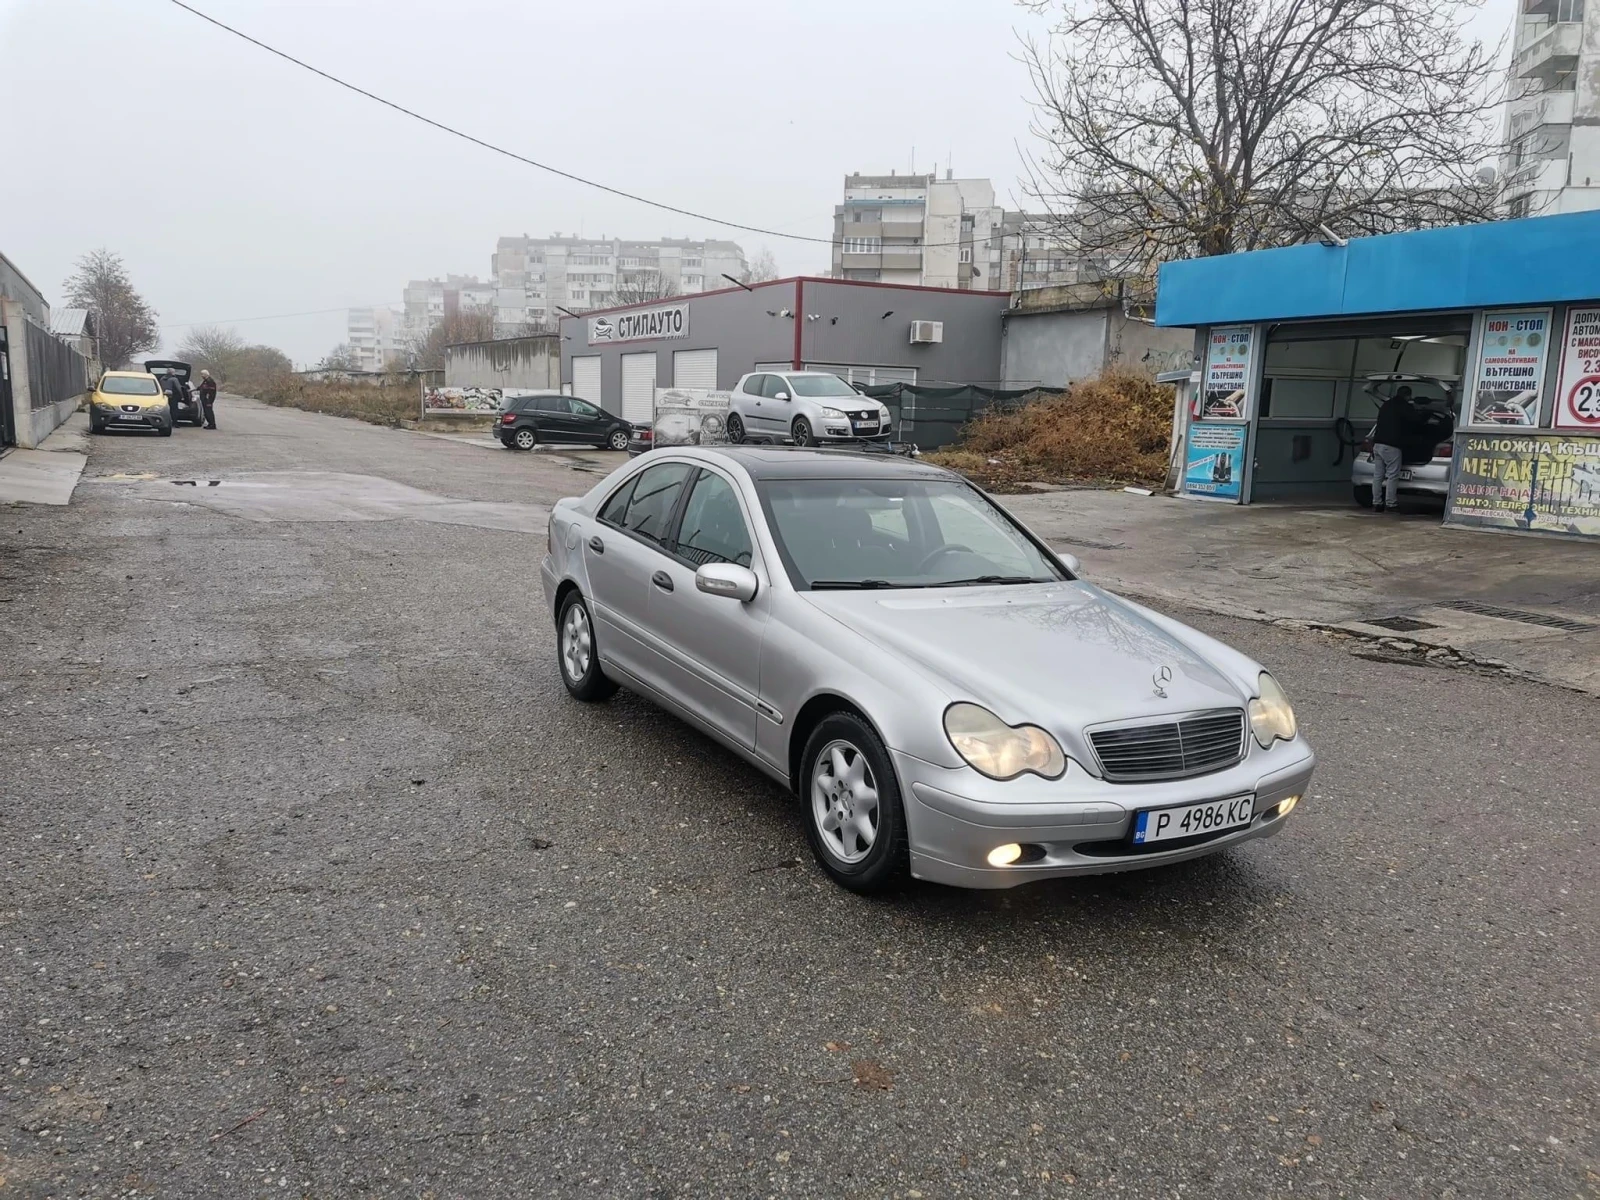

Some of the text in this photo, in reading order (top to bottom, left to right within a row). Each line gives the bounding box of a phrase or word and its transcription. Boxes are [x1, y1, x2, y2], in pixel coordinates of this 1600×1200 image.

[618, 309, 682, 338] СТИЛАУТО
[1574, 312, 1600, 324] ДОПУ
[1488, 321, 1508, 331] НОН
[1516, 319, 1543, 330] СТОП
[1213, 335, 1226, 343] НОН
[1231, 334, 1249, 343] СТОП
[1571, 337, 1600, 347] С МАКС
[1211, 371, 1243, 379] ВЪТРЕШНО
[1485, 367, 1534, 377] ВЪТРЕШНО
[1208, 382, 1244, 390] ПОЧИСТВАНЕ
[1480, 380, 1537, 390] ПОЧИСТВАНЕ
[1467, 438, 1552, 454] ЗАЛОЖНА
[1462, 457, 1573, 481] МЕГАКЕШ
[1457, 483, 1498, 496] ЗАЛОГ
[1500, 488, 1517, 498] НА
[1456, 497, 1492, 508] ЗЛАТО,
[1155, 799, 1251, 837] P 4986 KC
